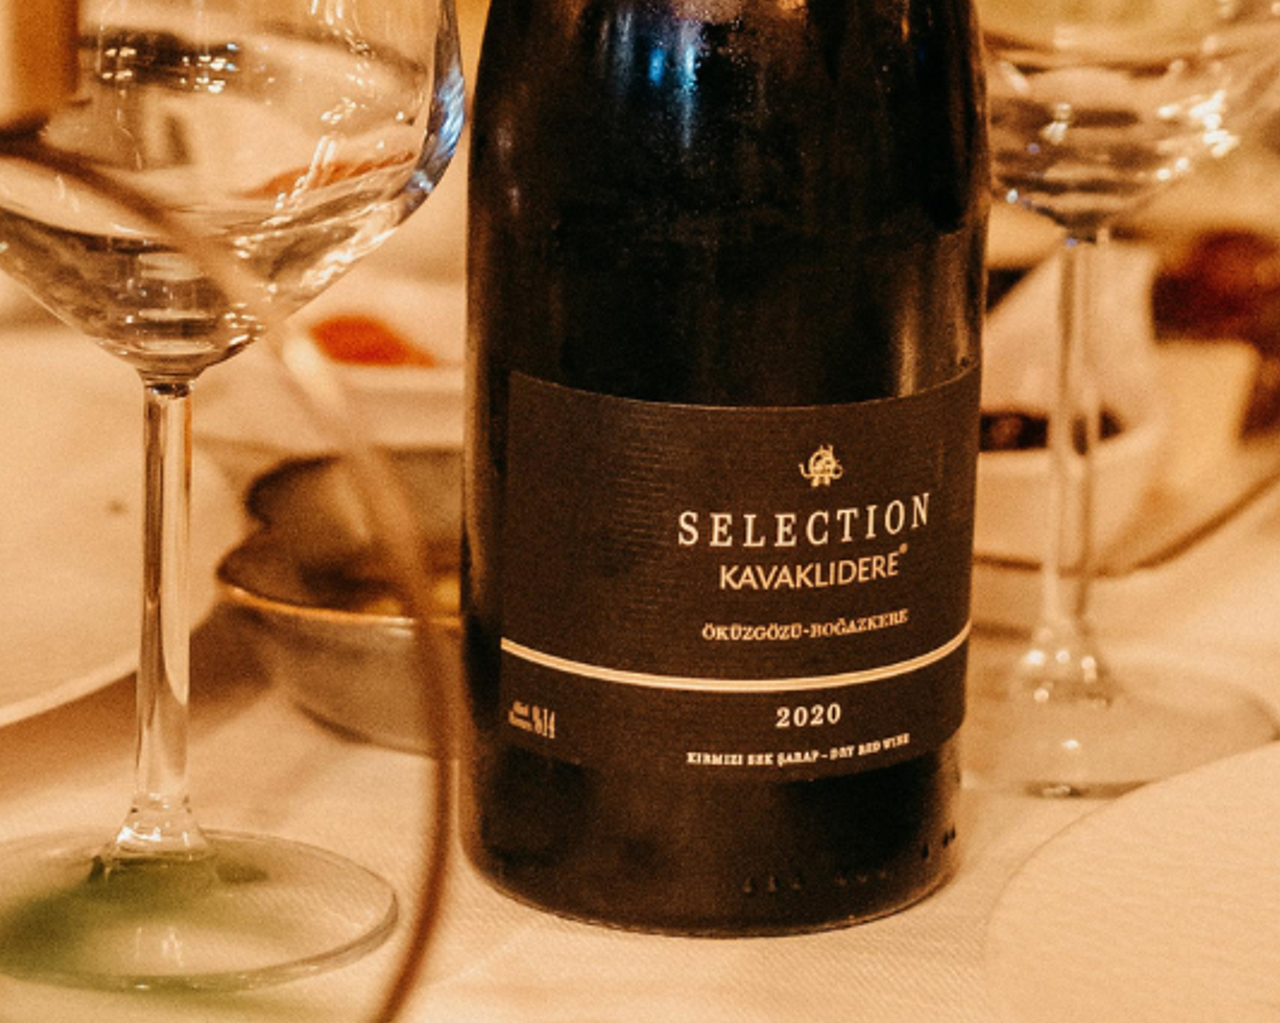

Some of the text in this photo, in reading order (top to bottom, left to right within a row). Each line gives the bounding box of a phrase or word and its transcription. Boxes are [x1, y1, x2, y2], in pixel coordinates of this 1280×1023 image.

[678, 492, 930, 548] SELECTION
[720, 551, 900, 590] KAVAKLIDERE
[775, 703, 842, 728] 2020
[686, 752, 744, 766] KIRMIZI
[747, 753, 774, 766] SEK
[858, 740, 881, 756] RED
[883, 733, 911, 750] WINE
